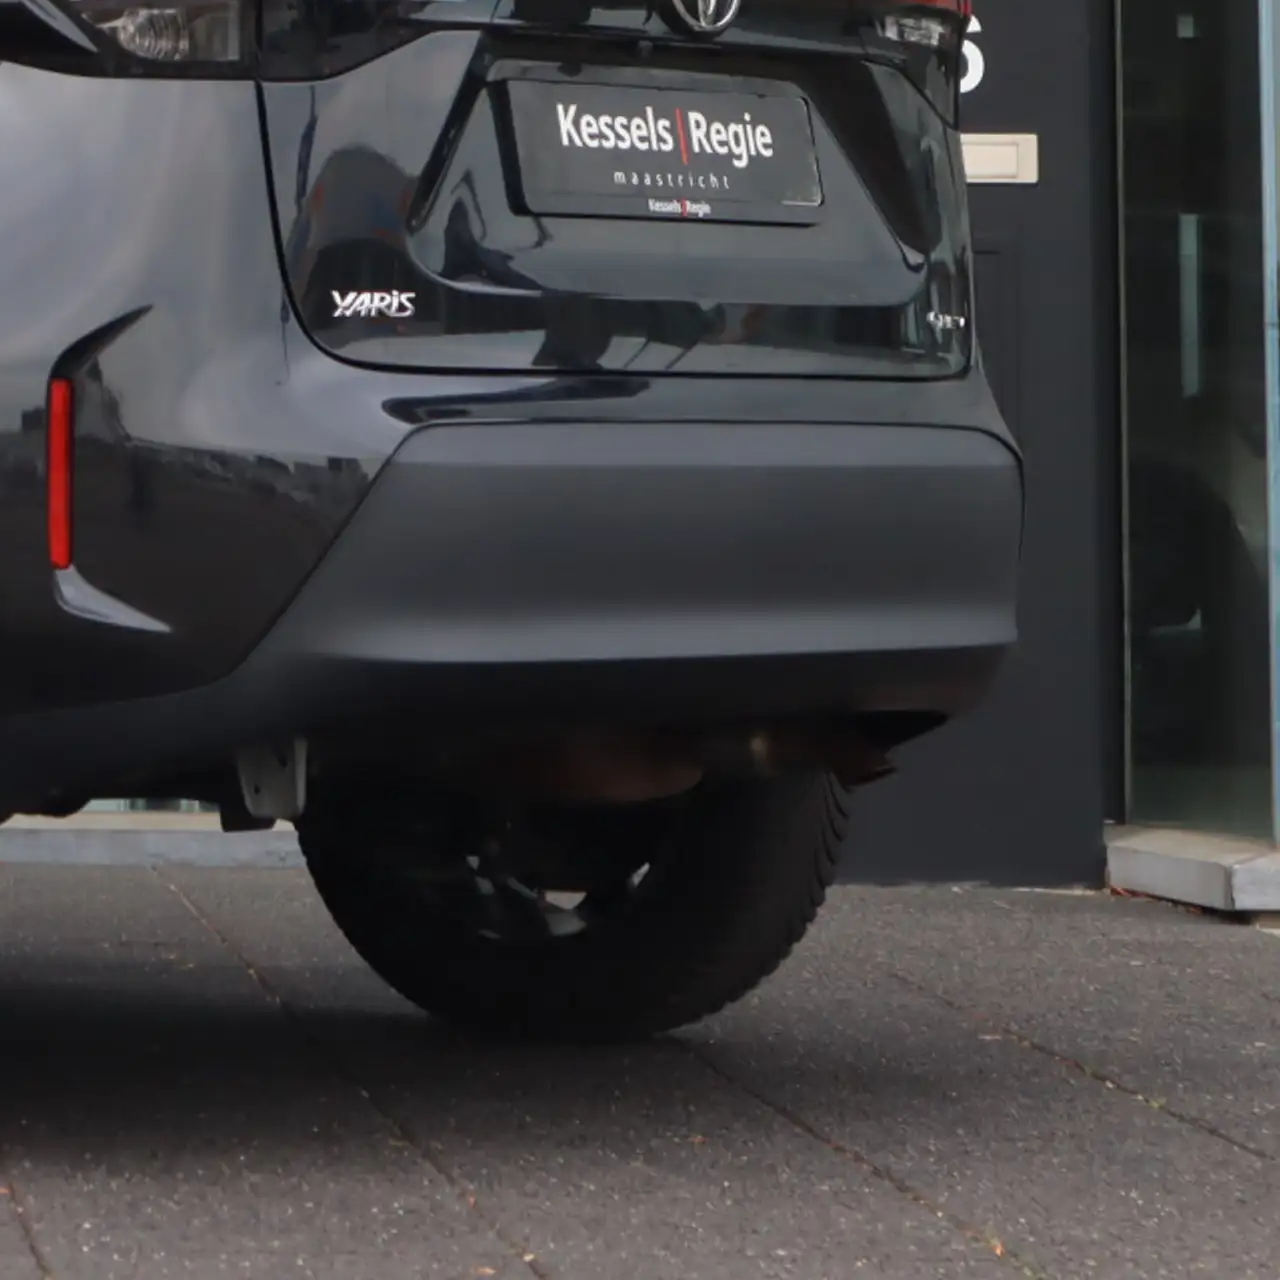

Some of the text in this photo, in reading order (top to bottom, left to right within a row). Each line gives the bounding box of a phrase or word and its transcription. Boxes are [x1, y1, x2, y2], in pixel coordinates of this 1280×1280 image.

[556, 103, 774, 168] Kessels Regie
[613, 169, 731, 189] maastricht
